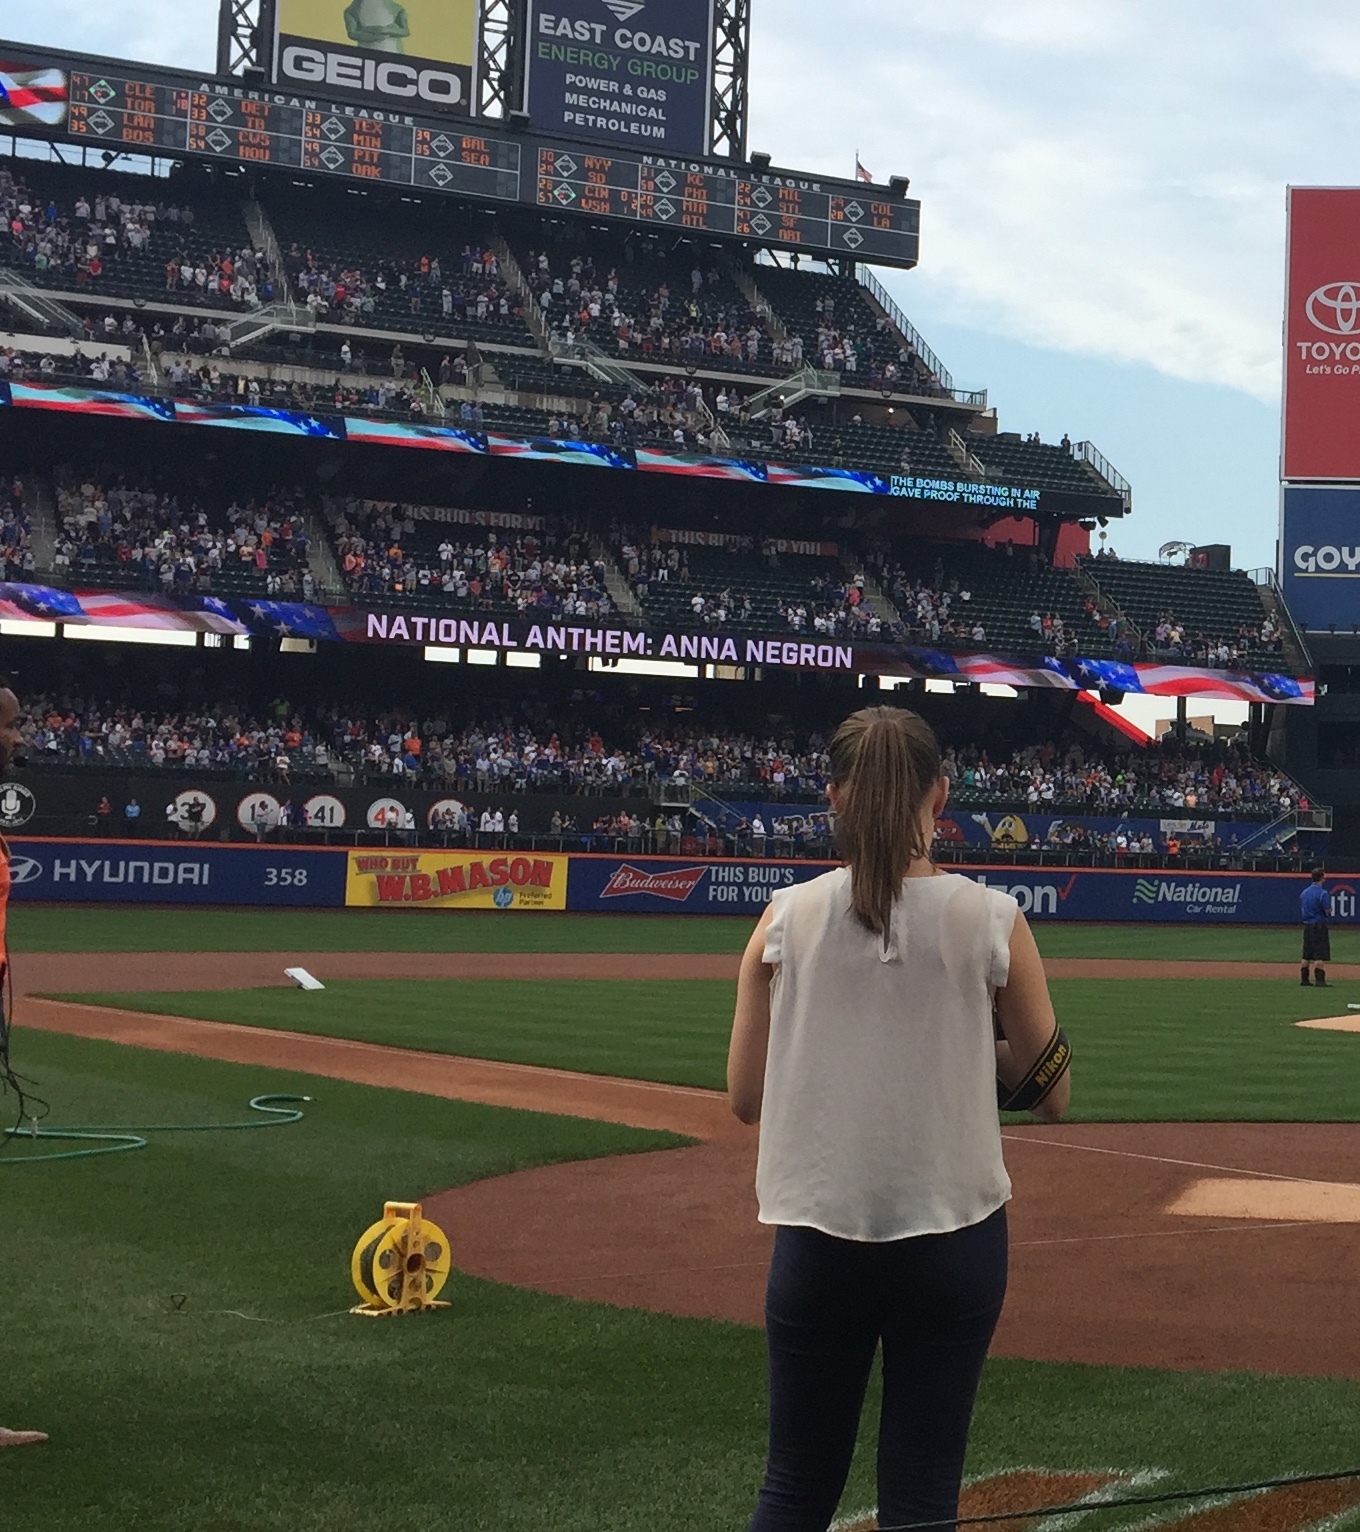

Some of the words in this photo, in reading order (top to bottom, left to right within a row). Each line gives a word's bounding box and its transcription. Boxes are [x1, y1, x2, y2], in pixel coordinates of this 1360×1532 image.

[539, 13, 606, 46] EAST
[614, 28, 700, 61] COAST
[538, 42, 621, 73] ENERGY
[628, 60, 699, 85] GROUP
[282, 46, 462, 104] GEICO
[125, 82, 155, 98] CLE
[566, 73, 620, 93] POWER
[623, 83, 634, 95] &
[637, 85, 666, 101] GAS
[125, 98, 155, 113] TOR
[192, 93, 207, 106] 32
[241, 101, 271, 116] DET
[199, 83, 316, 110] AMERICAN
[331, 104, 414, 126] LEAGUE
[565, 92, 666, 120] MECHANICAL
[191, 108, 206, 120] 33
[246, 116, 265, 130] TB
[306, 113, 321, 124] 33
[354, 119, 382, 134] TEX
[564, 111, 665, 139] PETROLEUM
[122, 128, 154, 143] BOS
[239, 131, 270, 146] CWS
[353, 134, 380, 149] MIN
[462, 137, 489, 152] BAL
[239, 145, 270, 160] HOU
[353, 149, 380, 162] PIT
[462, 152, 490, 166] SEA
[352, 163, 381, 178] OAK
[584, 156, 612, 171] NYY
[588, 171, 606, 184] SD
[643, 156, 738, 178] NATIONAL
[750, 174, 821, 192] LEAGUE
[687, 173, 704, 186] KC
[585, 185, 609, 198] CIN
[685, 187, 708, 200] PHI
[779, 188, 801, 202] MIL
[581, 199, 611, 213] WSH
[683, 201, 707, 214] MIA
[779, 202, 802, 216] STL
[871, 203, 894, 216] COL
[682, 215, 708, 229] ATL
[782, 215, 798, 228] SF
[873, 216, 890, 228] LA
[779, 229, 801, 242] ARI
[1306, 364, 1331, 375] Let's
[1334, 364, 1349, 375] Go
[893, 475, 914, 487] THE
[916, 478, 954, 492] BOMBS
[957, 482, 1009, 497] BURSTING
[1011, 488, 1021, 498] IN
[1023, 489, 1040, 500] AIR
[892, 486, 921, 498] GAVE
[924, 490, 960, 502] PROOF
[962, 493, 1014, 508] THROUGH
[1017, 498, 1037, 510] THE
[367, 613, 517, 649] NATIONAL
[527, 625, 653, 657] ANTHEM:
[660, 633, 738, 662] ANNA
[746, 640, 852, 669] NEGRON
[314, 805, 335, 824] 41
[356, 857, 389, 871] WHO
[391, 858, 419, 870] BUT
[53, 859, 210, 885] HYUNDAI
[264, 867, 308, 886] 358
[710, 866, 744, 883] THIS
[749, 867, 794, 884] BUD'S
[610, 871, 696, 890] Budweiser
[709, 885, 739, 902] FOR
[742, 886, 773, 903] YOU
[1158, 881, 1241, 904] National
[1186, 904, 1201, 914] Car
[1205, 904, 1236, 914] Rental
[1035, 1044, 1067, 1087] Nikon
